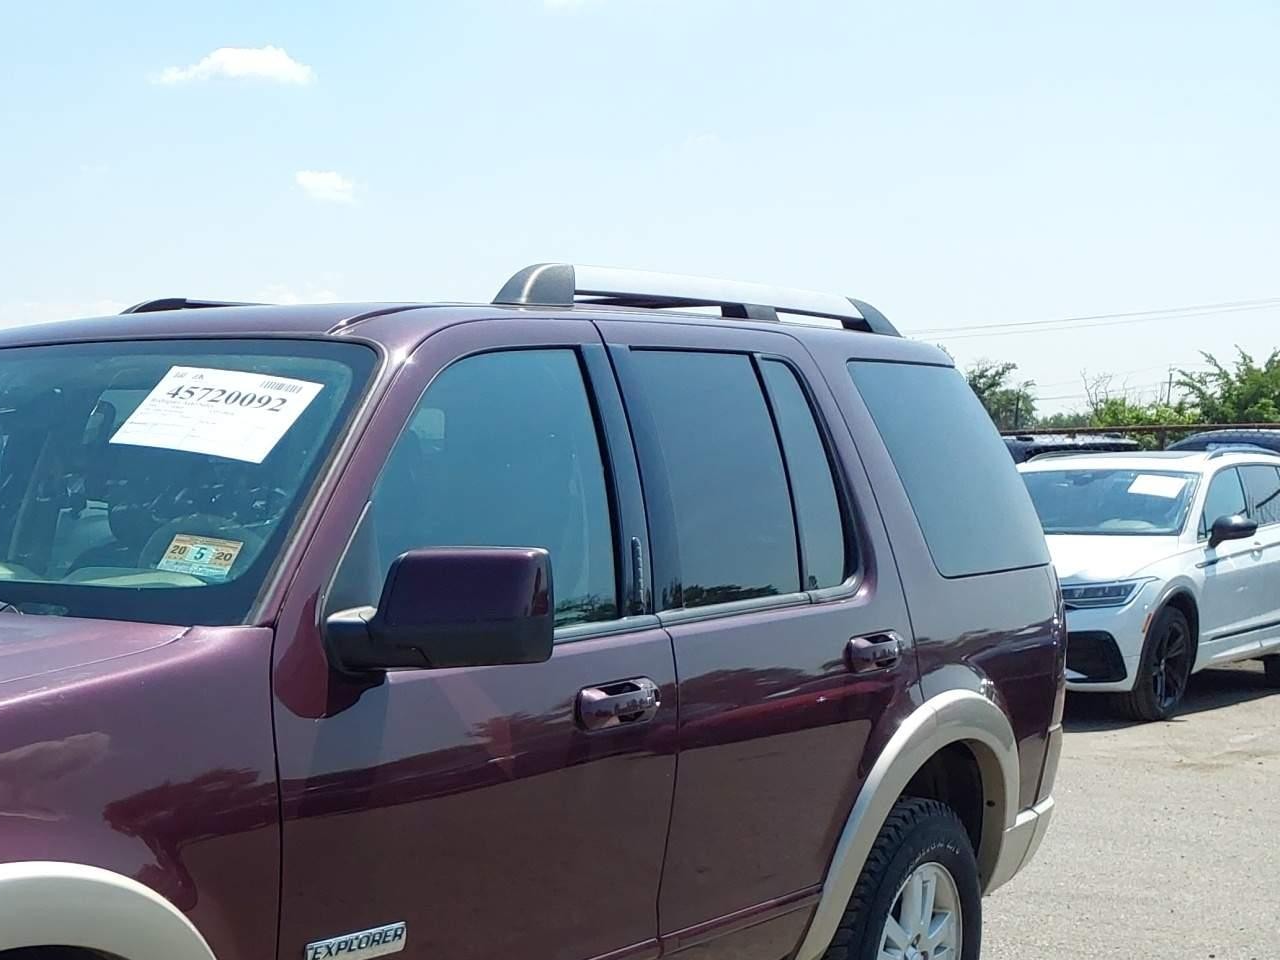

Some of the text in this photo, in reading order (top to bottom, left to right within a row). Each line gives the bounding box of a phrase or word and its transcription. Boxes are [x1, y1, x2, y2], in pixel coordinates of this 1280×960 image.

[166, 384, 288, 412] 45720092
[170, 545, 187, 555] 20
[194, 547, 207, 560] 5
[215, 551, 233, 562] 20
[311, 926, 405, 960] EXPLORER
